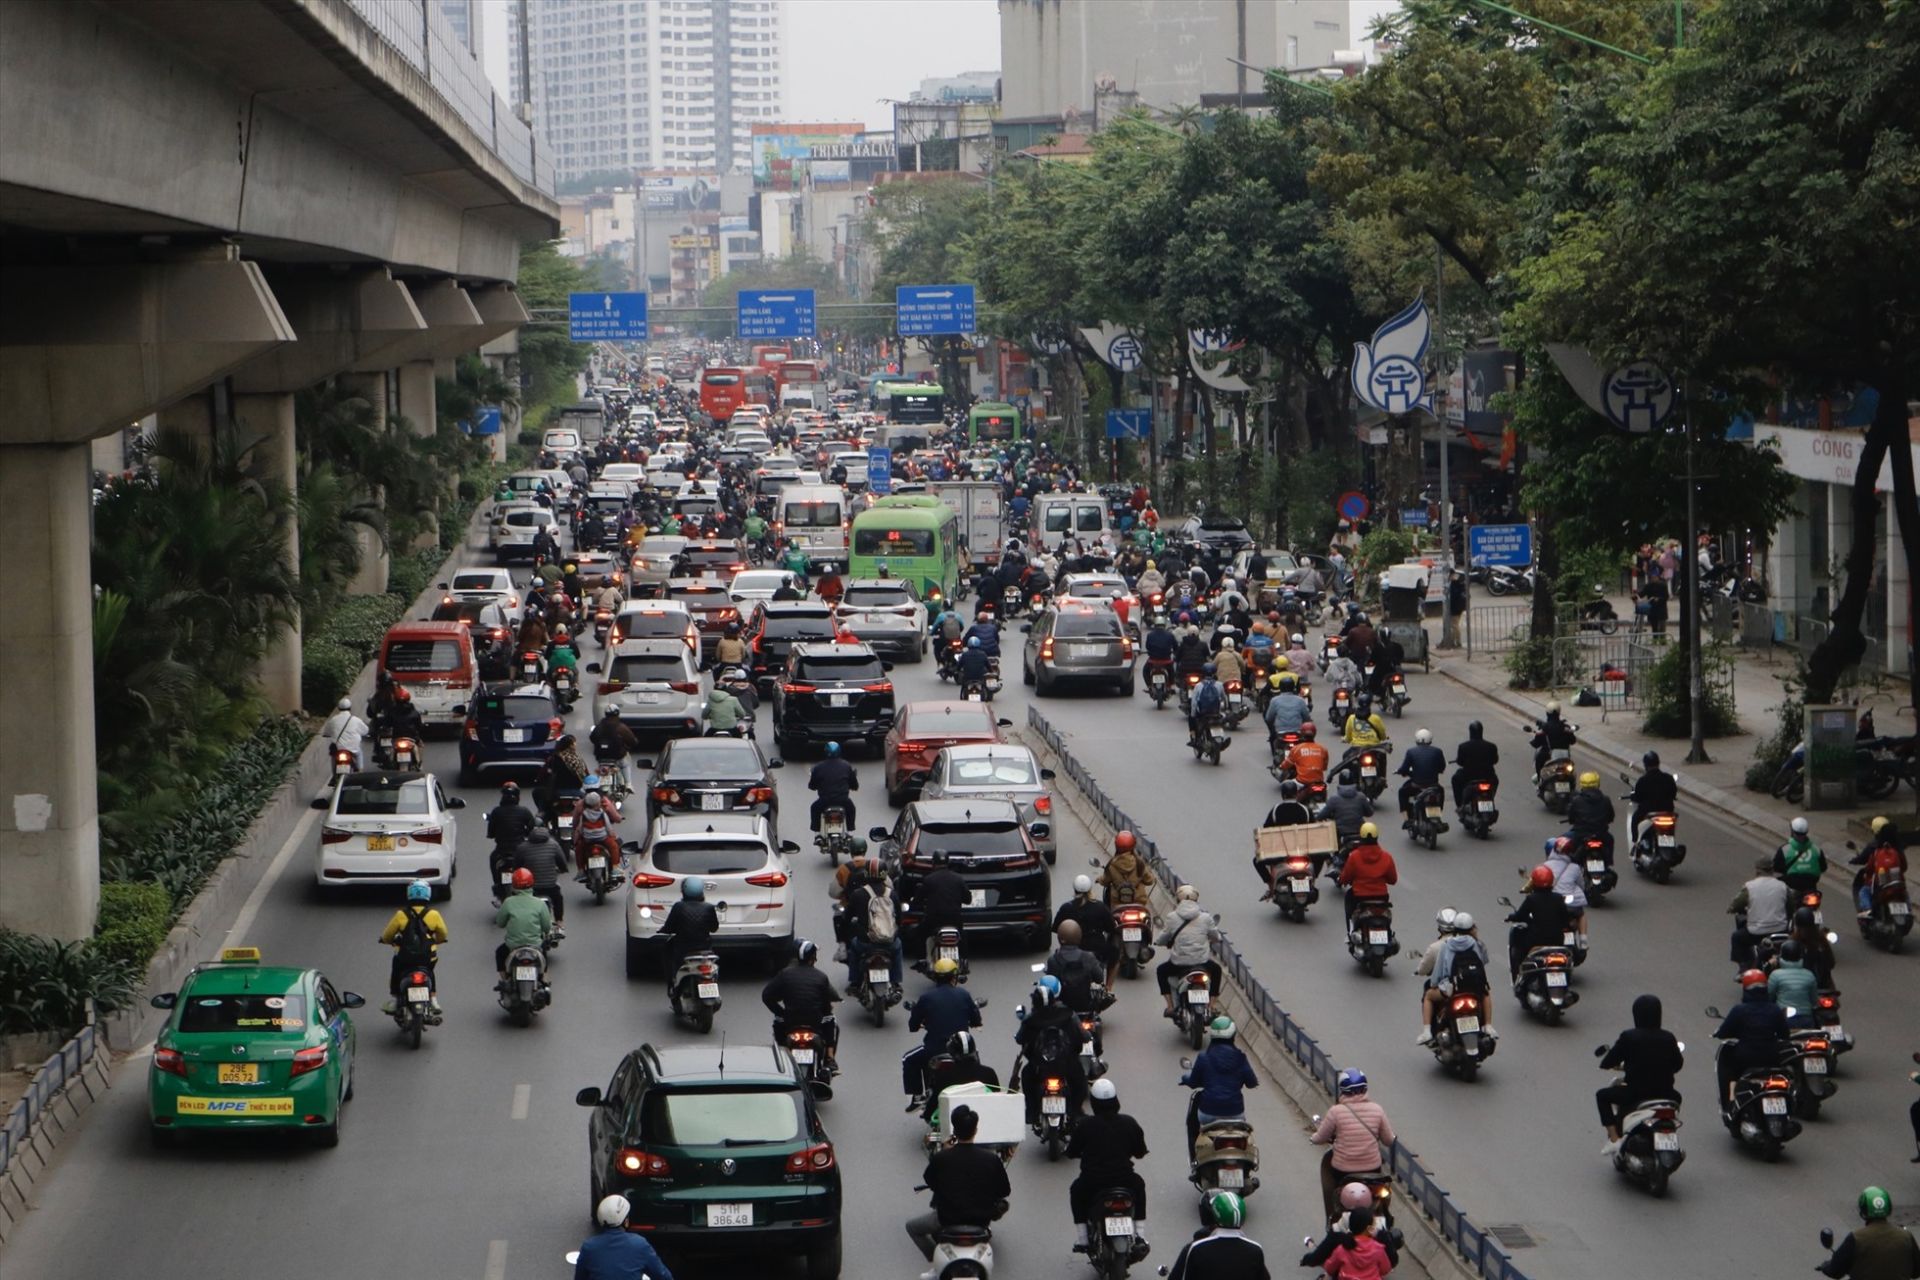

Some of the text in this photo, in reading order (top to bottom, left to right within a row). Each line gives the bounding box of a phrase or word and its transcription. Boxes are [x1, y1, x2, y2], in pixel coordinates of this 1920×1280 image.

[1812, 434, 1853, 460] CÔNG
[230, 1064, 246, 1073] 29E
[222, 1073, 253, 1082] 005.72
[207, 1102, 246, 1111] MPE
[721, 1204, 740, 1214] 51H
[714, 1215, 748, 1225] 386.48
